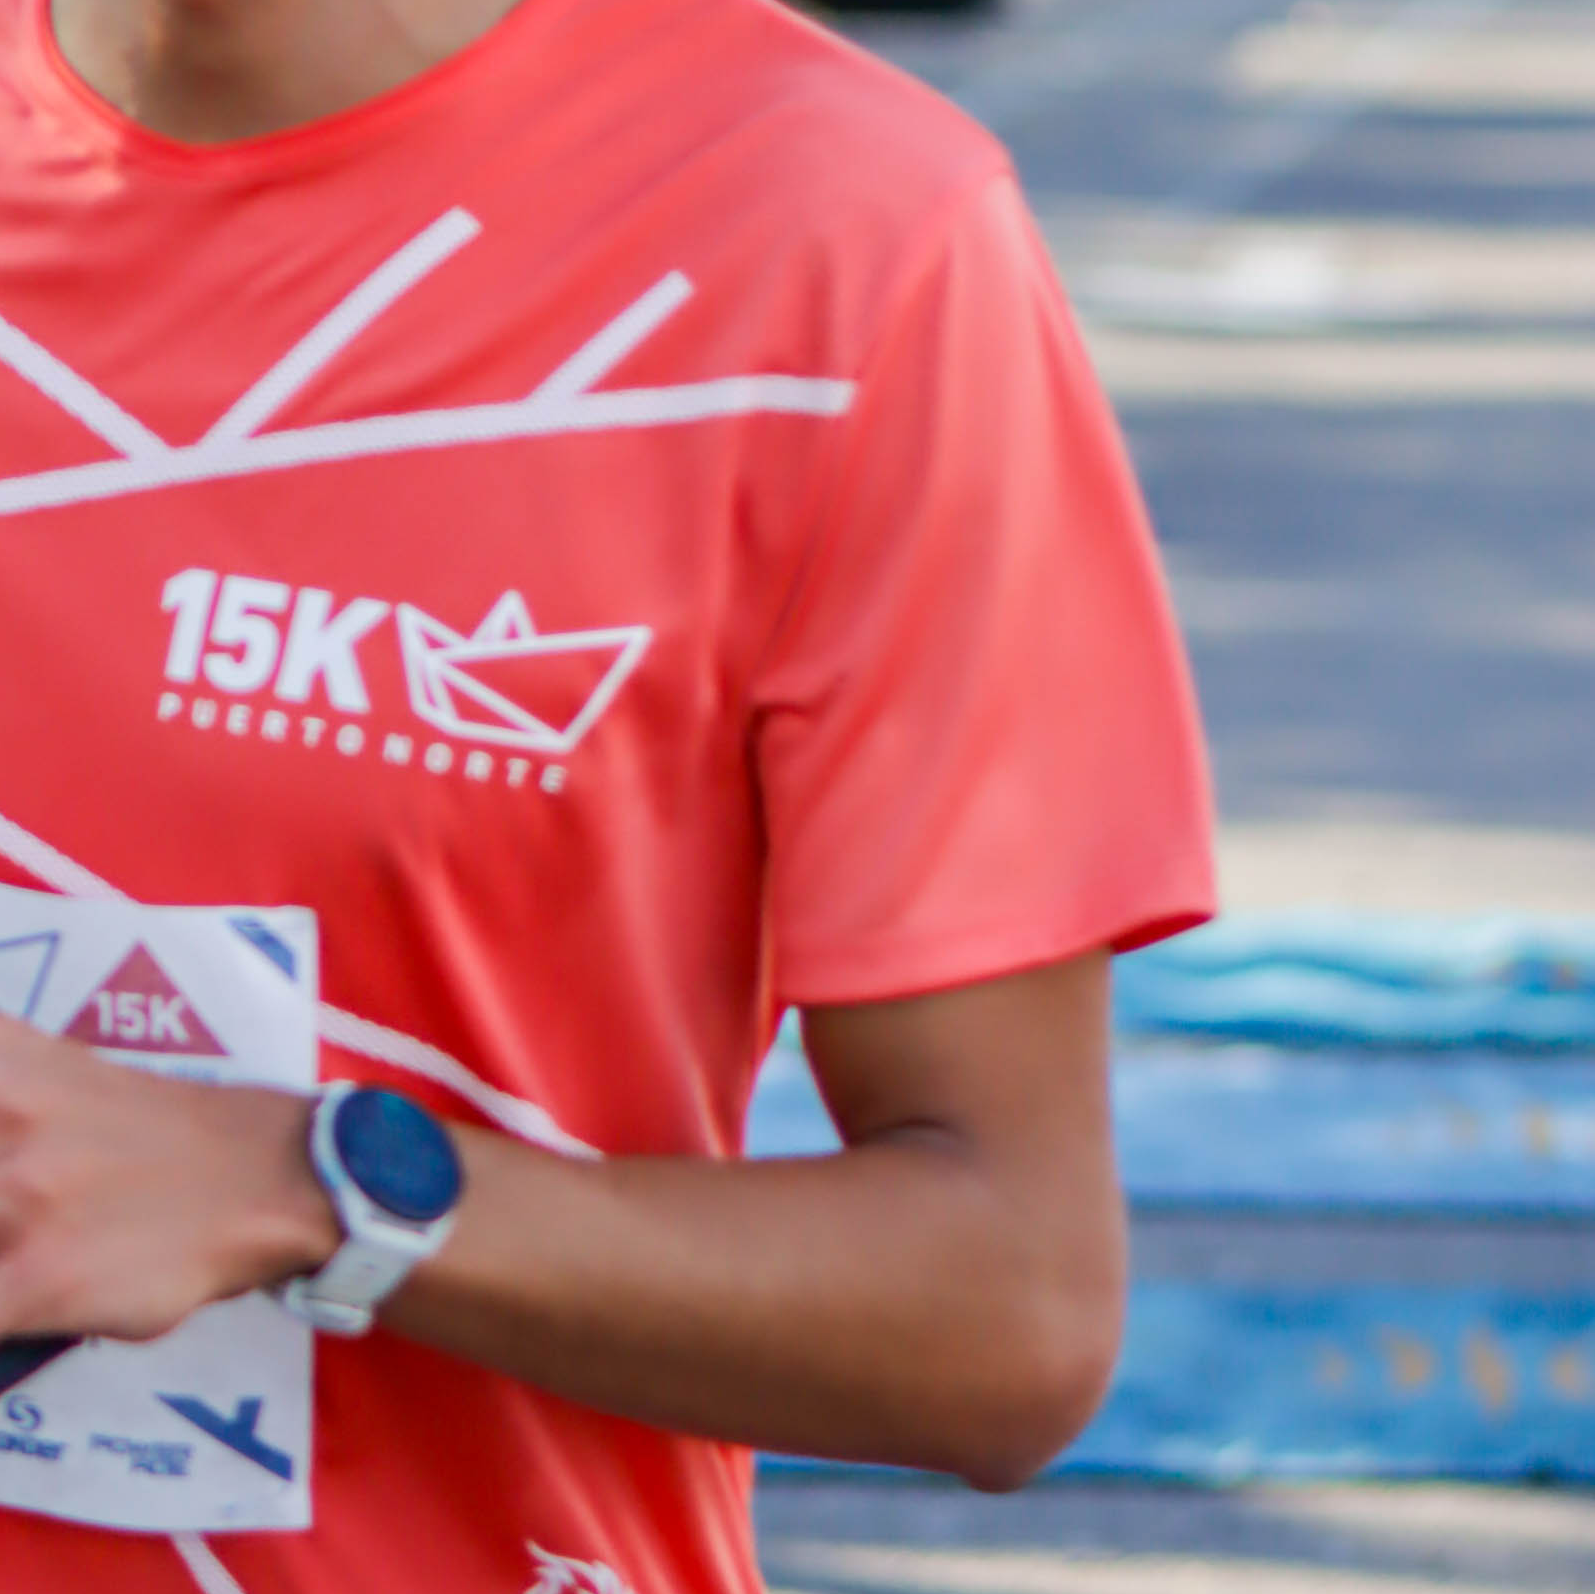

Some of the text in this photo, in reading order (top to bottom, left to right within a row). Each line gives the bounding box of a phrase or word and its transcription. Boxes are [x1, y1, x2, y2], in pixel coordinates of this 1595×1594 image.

[161, 568, 390, 713] 15K
[157, 691, 568, 794] PUERTO NORTE
[96, 989, 191, 1044] 15K
